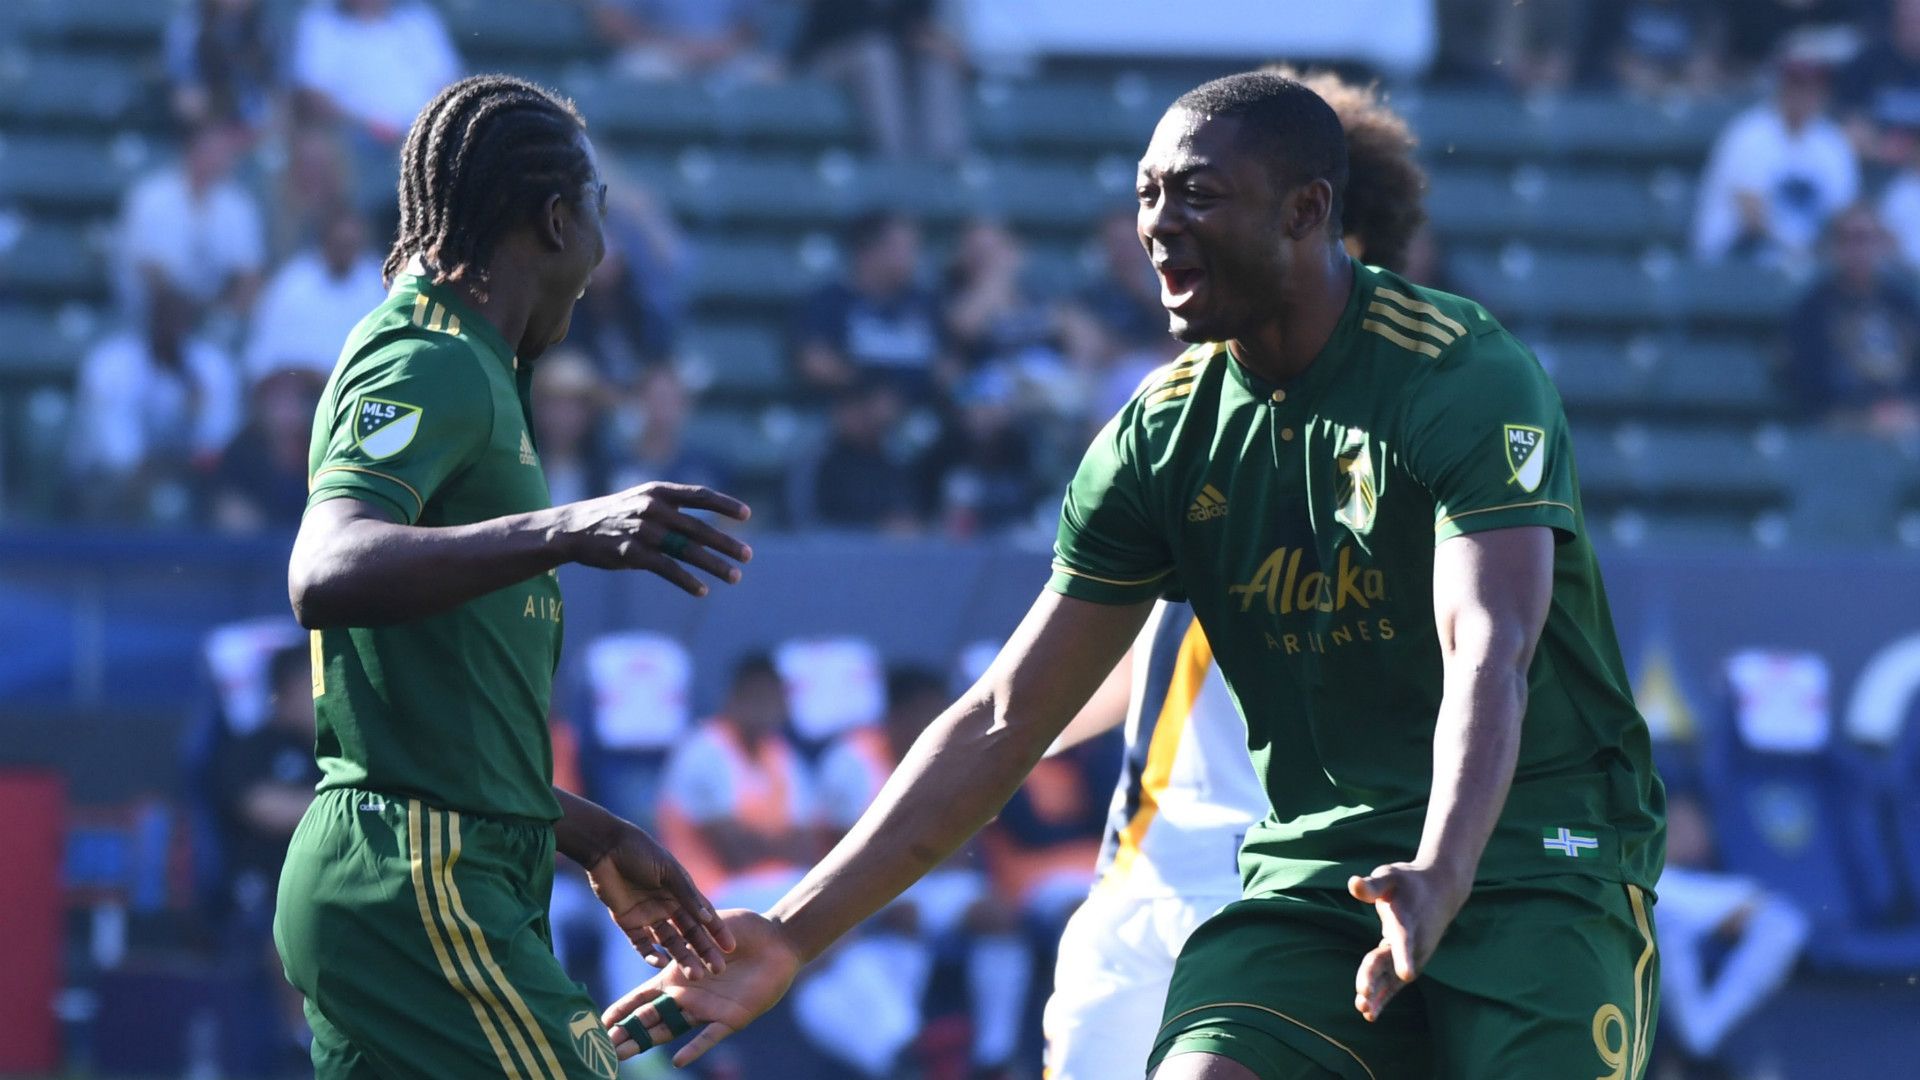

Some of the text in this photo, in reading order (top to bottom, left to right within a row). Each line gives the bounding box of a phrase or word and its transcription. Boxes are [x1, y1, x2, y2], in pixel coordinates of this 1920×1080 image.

[362, 402, 396, 419] MLS
[1509, 429, 1535, 447] MLS
[1592, 1003, 1629, 1080] 9
